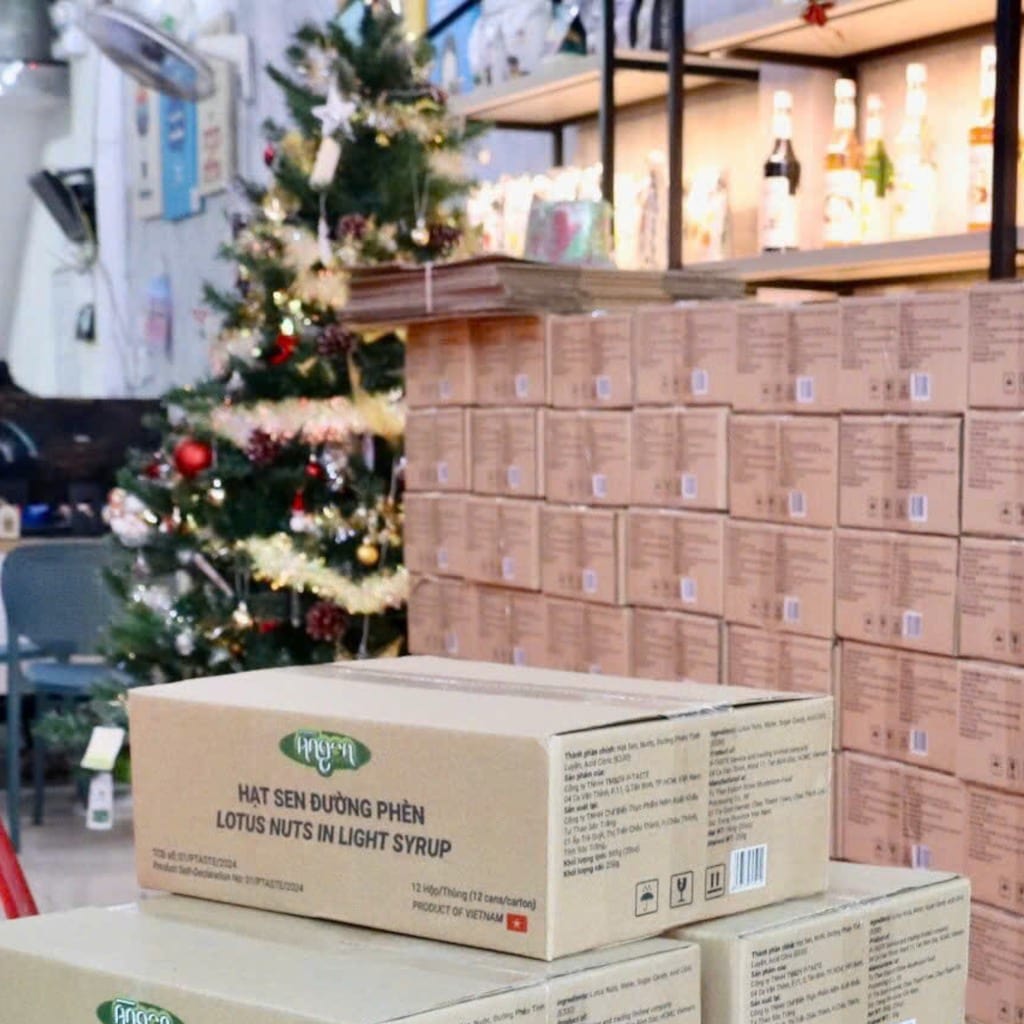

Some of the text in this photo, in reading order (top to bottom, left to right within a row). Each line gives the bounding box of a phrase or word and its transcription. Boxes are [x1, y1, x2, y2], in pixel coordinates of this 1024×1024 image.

[237, 783, 424, 824] HẠT SEN ĐƯỜNG PHÈN
[216, 810, 451, 857] LOTUS NUTS IN LIGHT SYRUP
